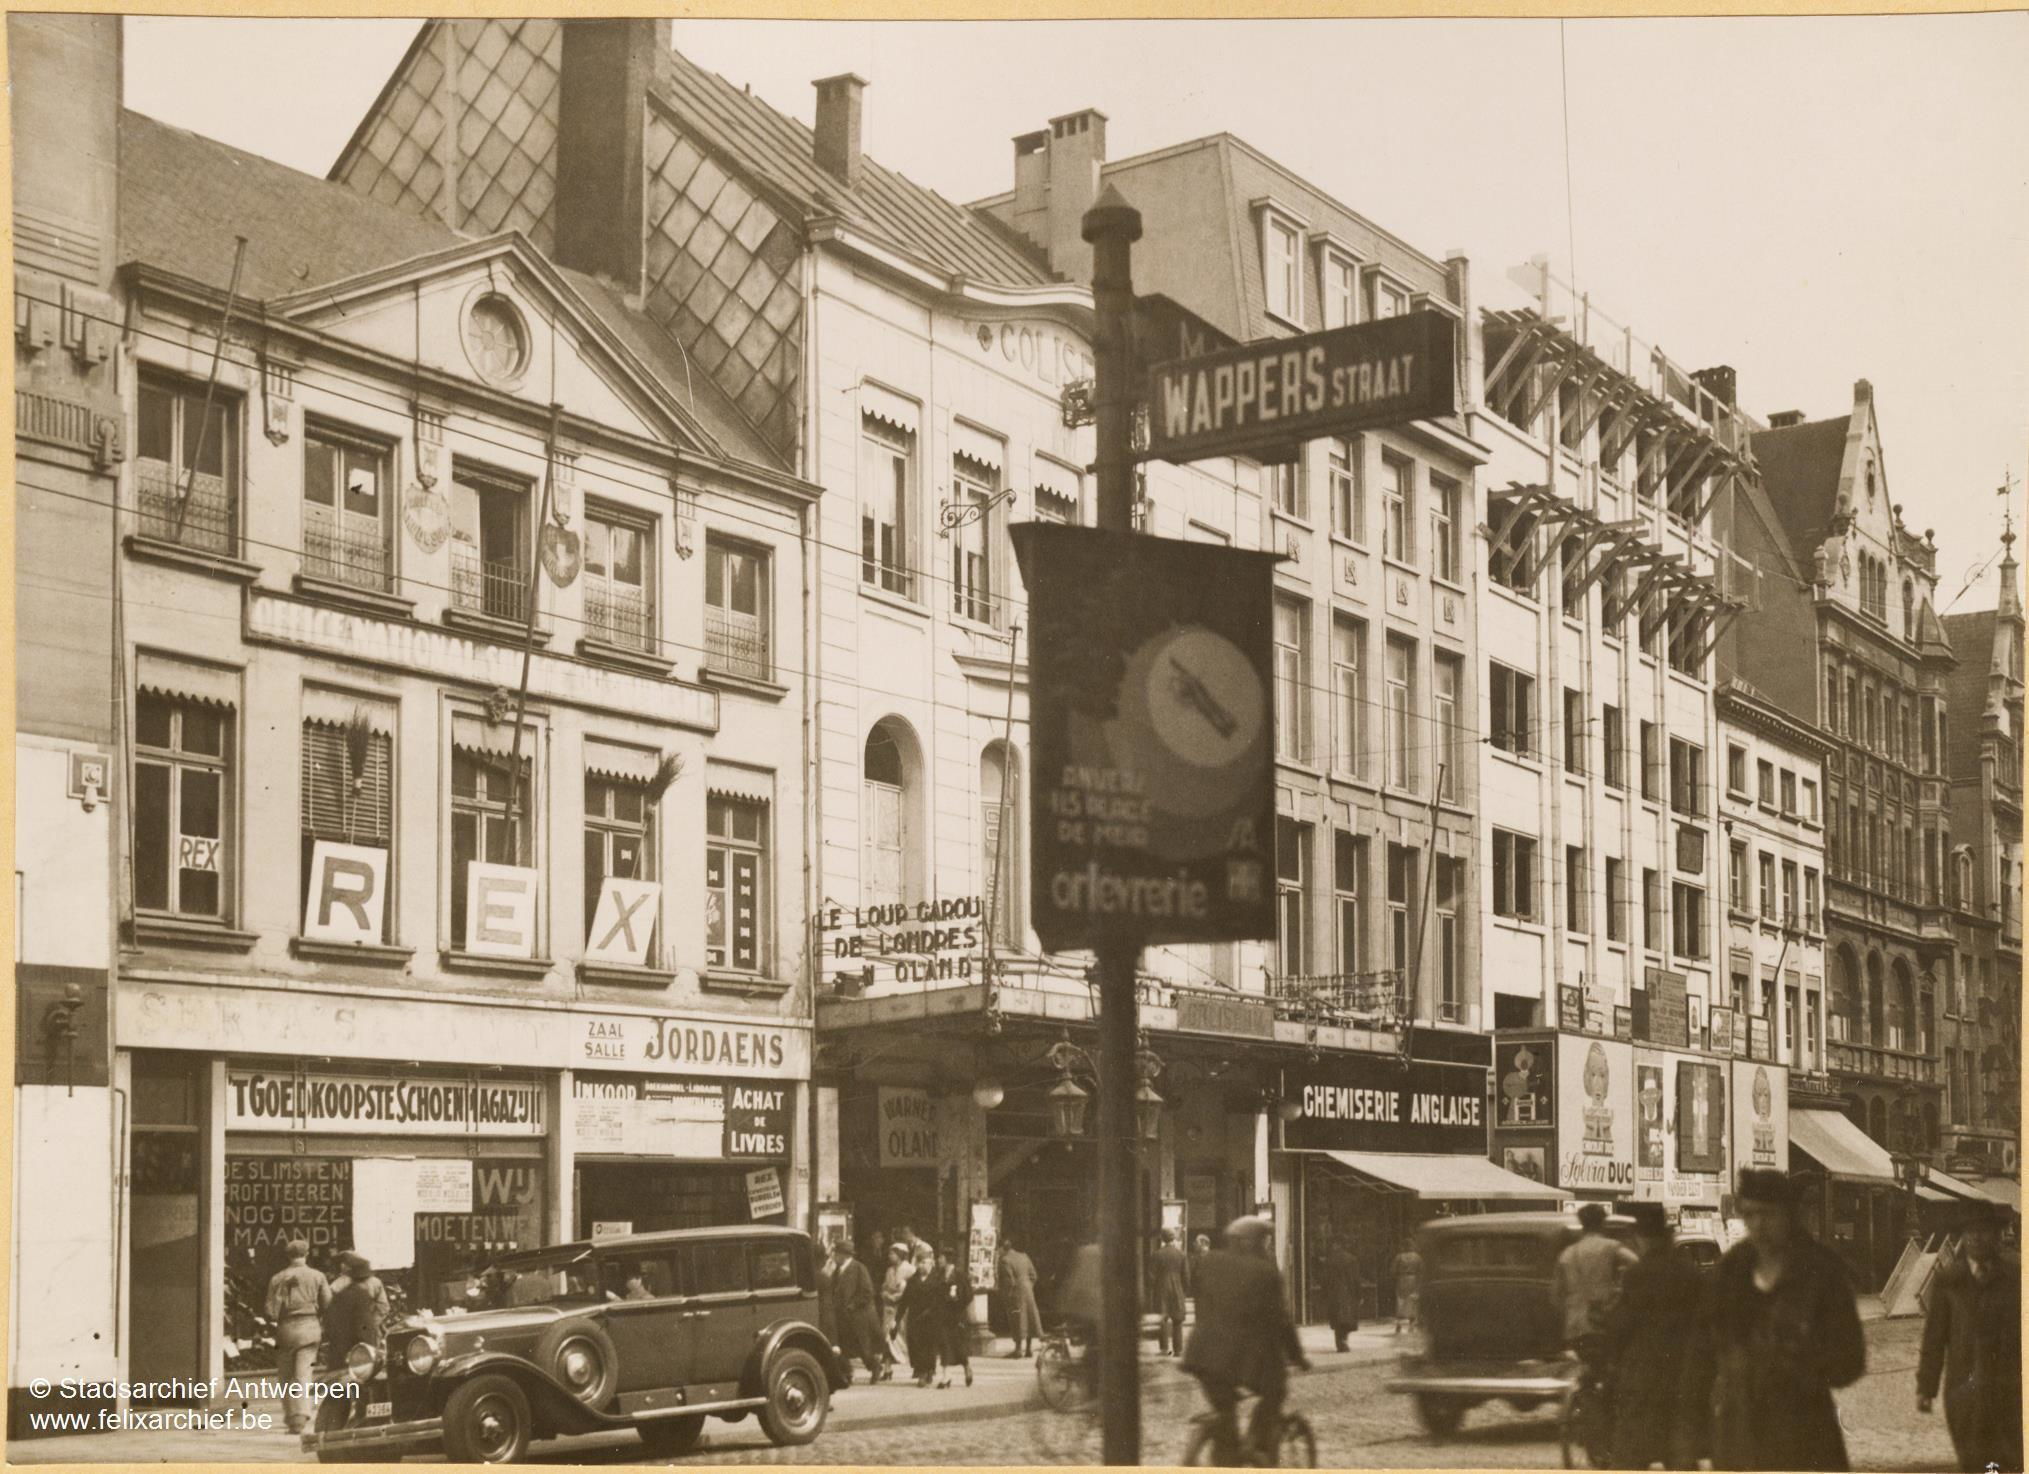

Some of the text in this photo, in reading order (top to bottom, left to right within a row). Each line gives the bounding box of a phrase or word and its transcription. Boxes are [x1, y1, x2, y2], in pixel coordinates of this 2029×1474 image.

[1163, 346, 1414, 438] WAPPERS STRAAT
[180, 837, 220, 870] REX
[818, 896, 982, 931] LE LOUP GAROU
[835, 926, 977, 958] DE LONDRES
[895, 957, 973, 983] OLAND
[588, 1021, 625, 1038] ZAAL
[584, 1041, 625, 1057] SALLE
[643, 1017, 784, 1067] JORDAENS
[732, 1087, 784, 1111] ACHAT
[1303, 1085, 1481, 1126] CHEMISERIE ANGLAISE
[754, 1115, 767, 1127] DE
[731, 1131, 785, 1153] LIVRES
[248, 1161, 349, 1181] SLIMSTEN!
[1608, 1161, 1633, 1184] DUC
[225, 1204, 345, 1224] NOG DEZE
[234, 1226, 338, 1246] MAAND!
[416, 1215, 498, 1242] MOETEN
